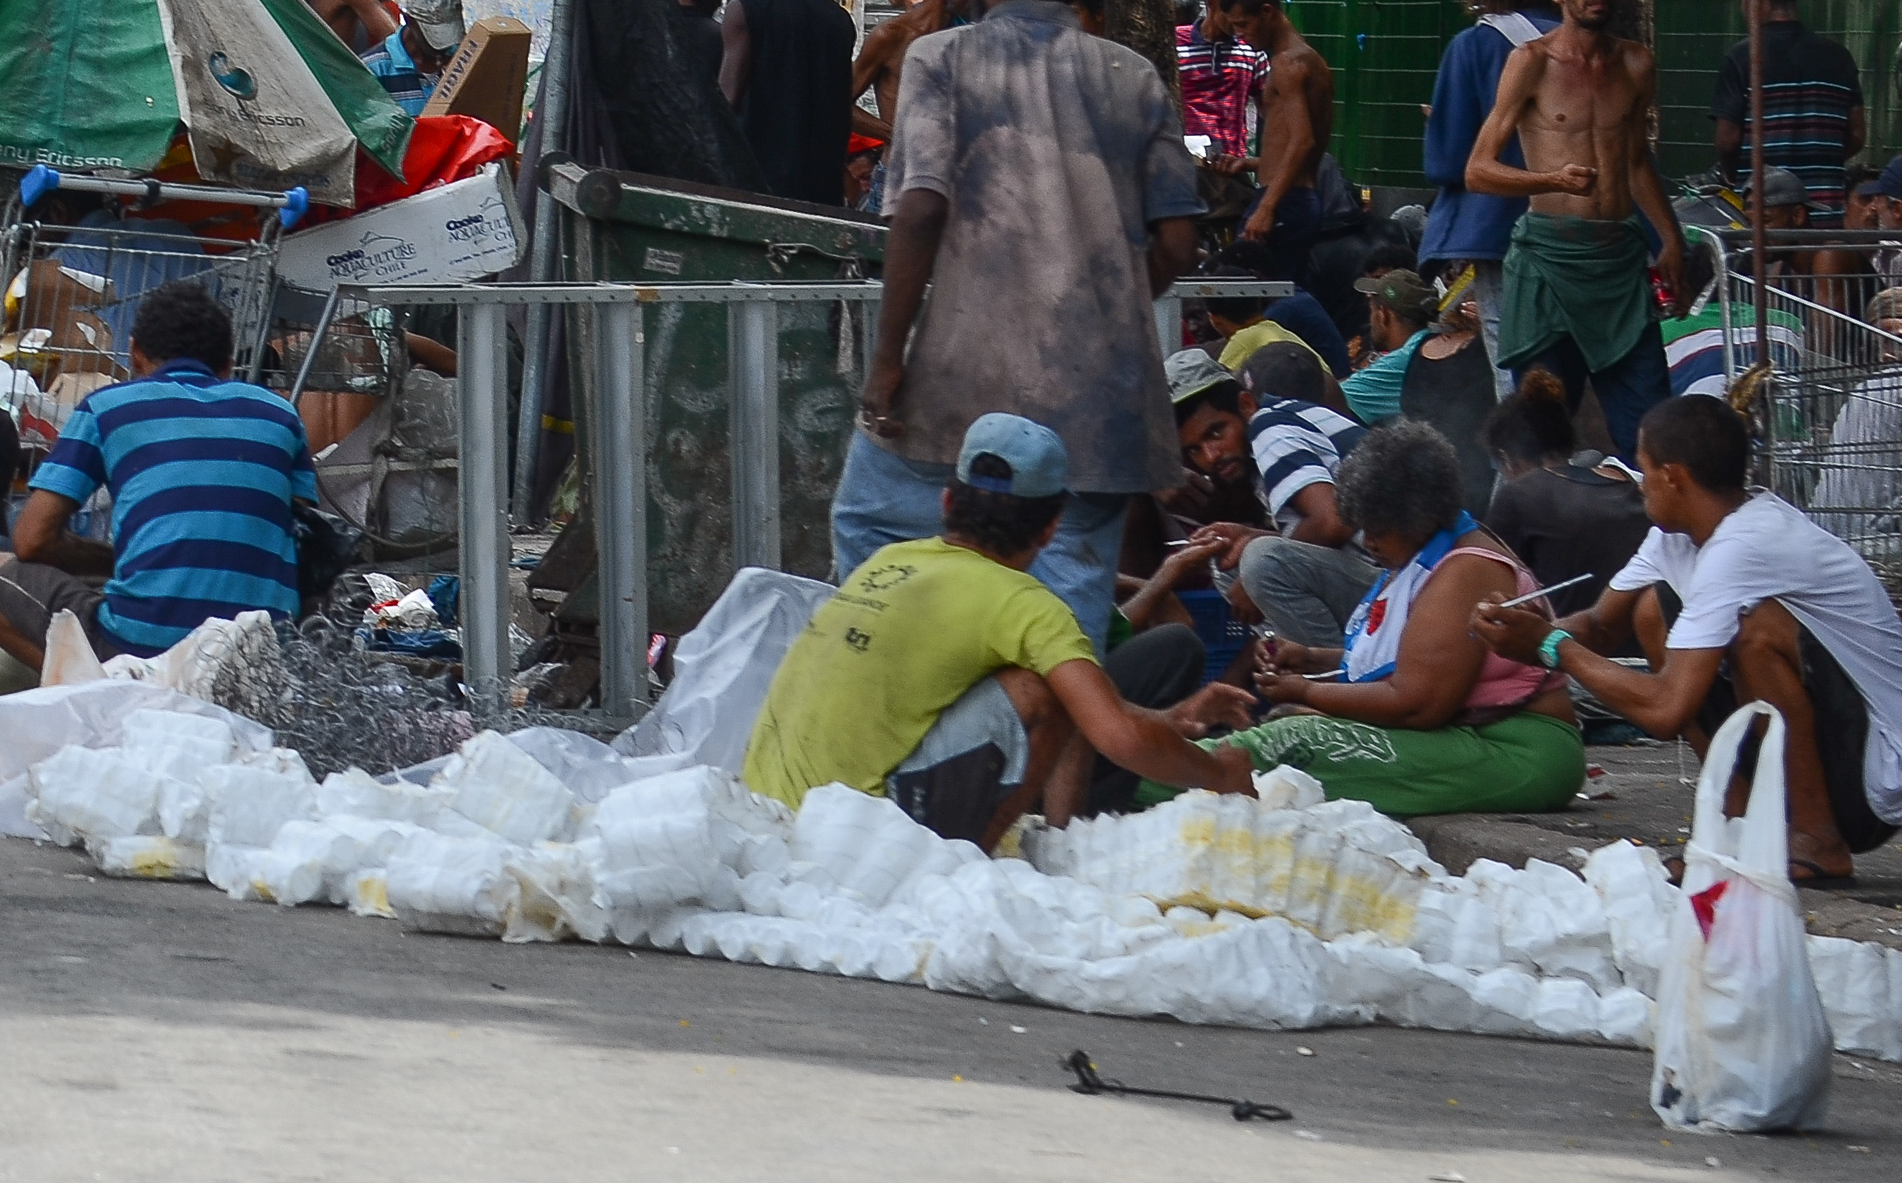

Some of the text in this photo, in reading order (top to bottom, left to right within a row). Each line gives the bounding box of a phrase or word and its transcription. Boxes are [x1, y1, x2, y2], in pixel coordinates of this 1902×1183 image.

[35, 147, 124, 168] Ericsson
[329, 242, 418, 279] AQUACULTURE
[375, 261, 407, 277] CHILE
